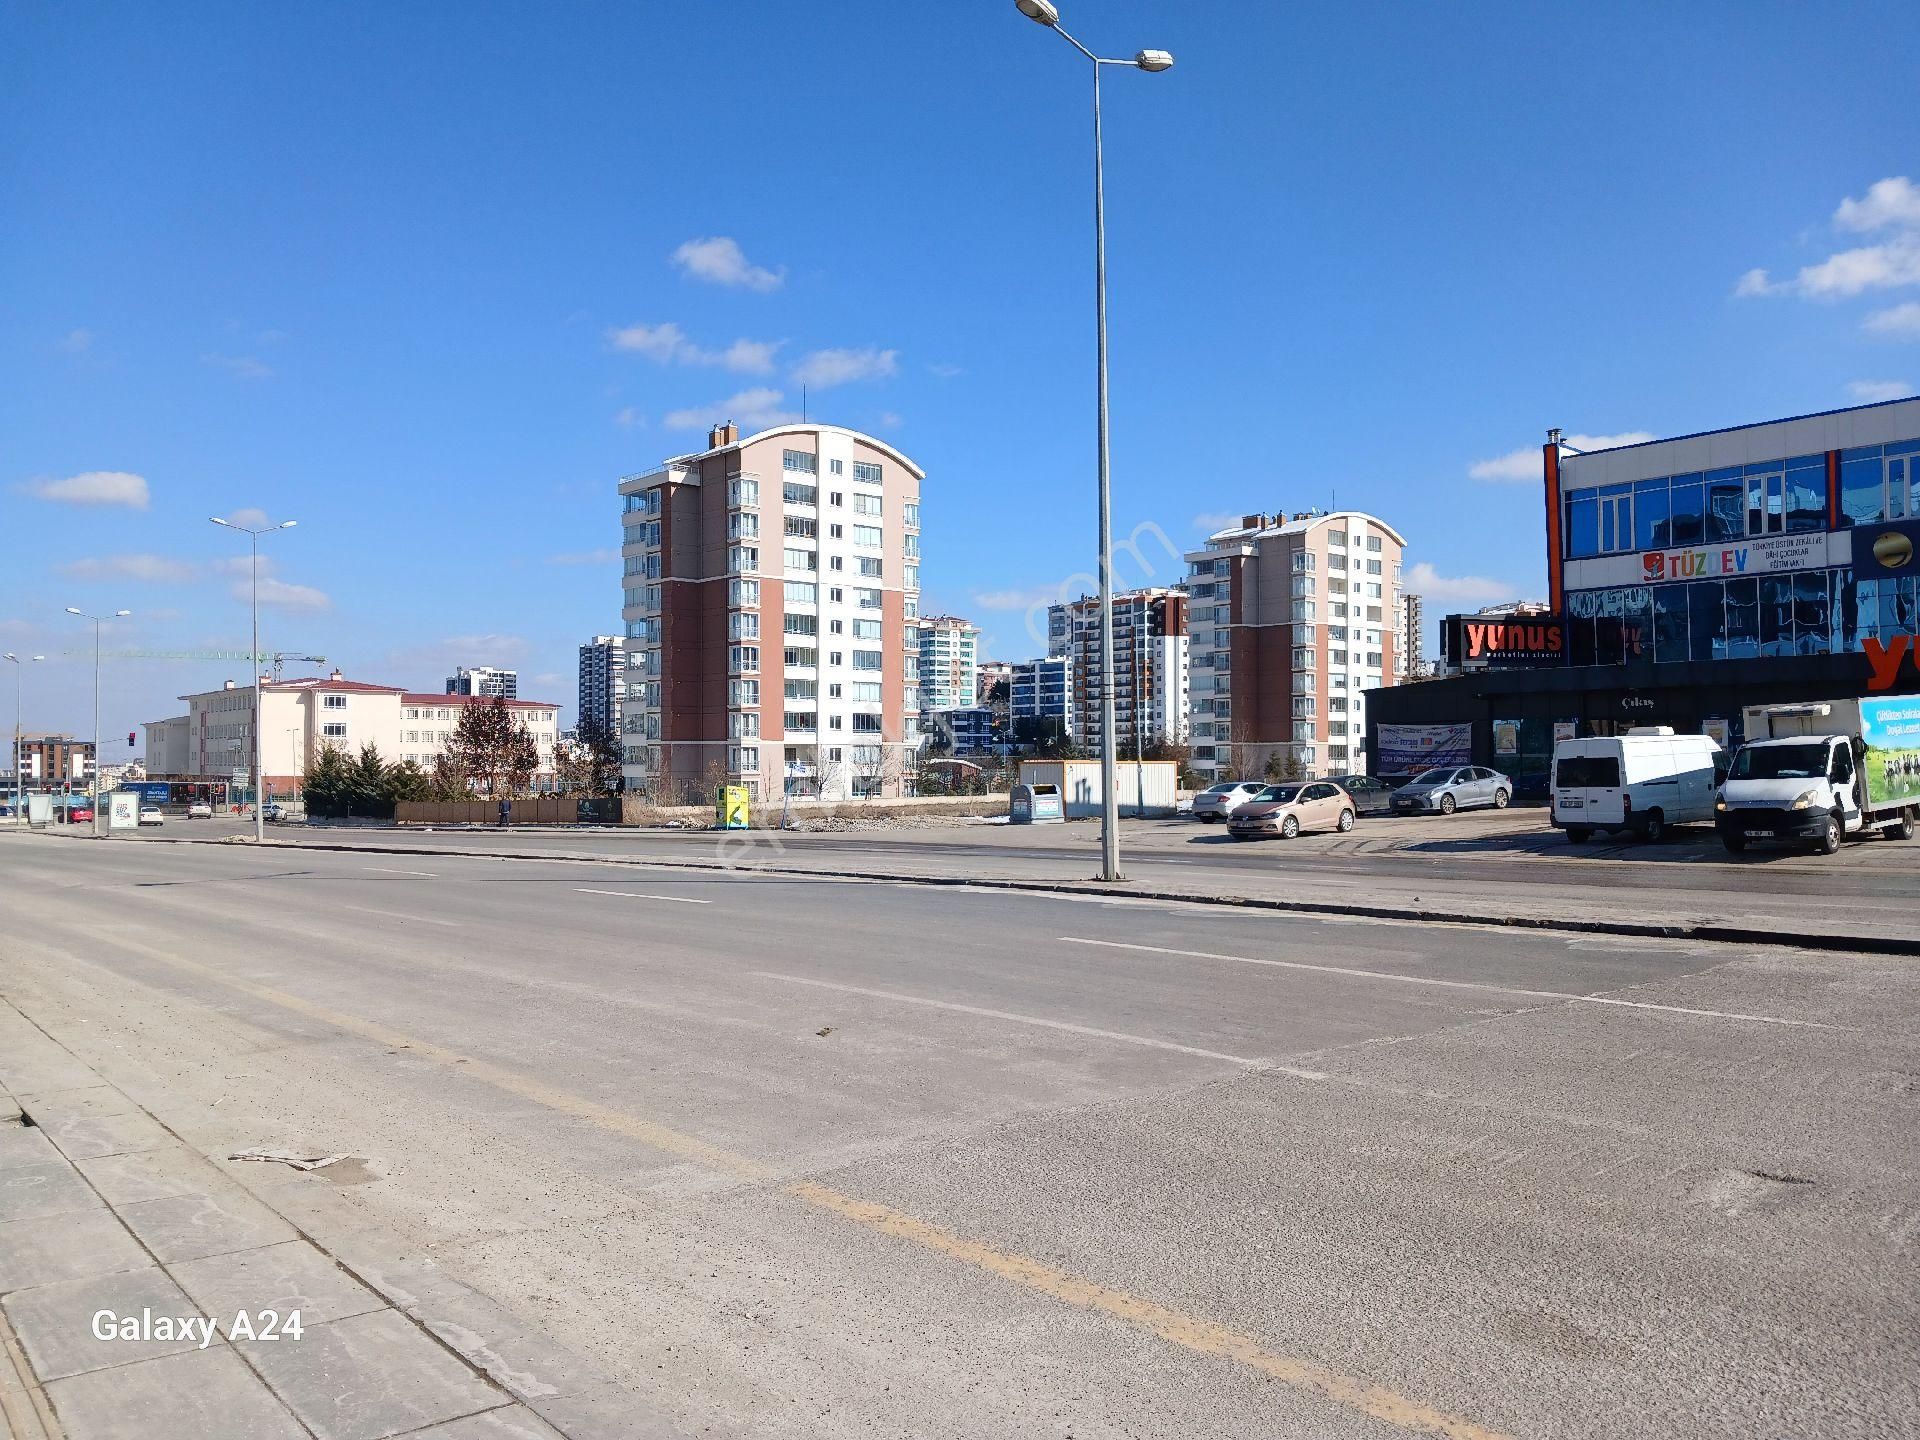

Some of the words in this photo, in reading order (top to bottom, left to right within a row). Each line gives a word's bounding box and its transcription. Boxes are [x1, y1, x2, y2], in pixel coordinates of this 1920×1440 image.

[1669, 549, 1748, 578] TÜZDEV
[1466, 624, 1562, 657] yunus
[1860, 634, 1920, 691] y
[1621, 696, 1655, 709] Çıkış
